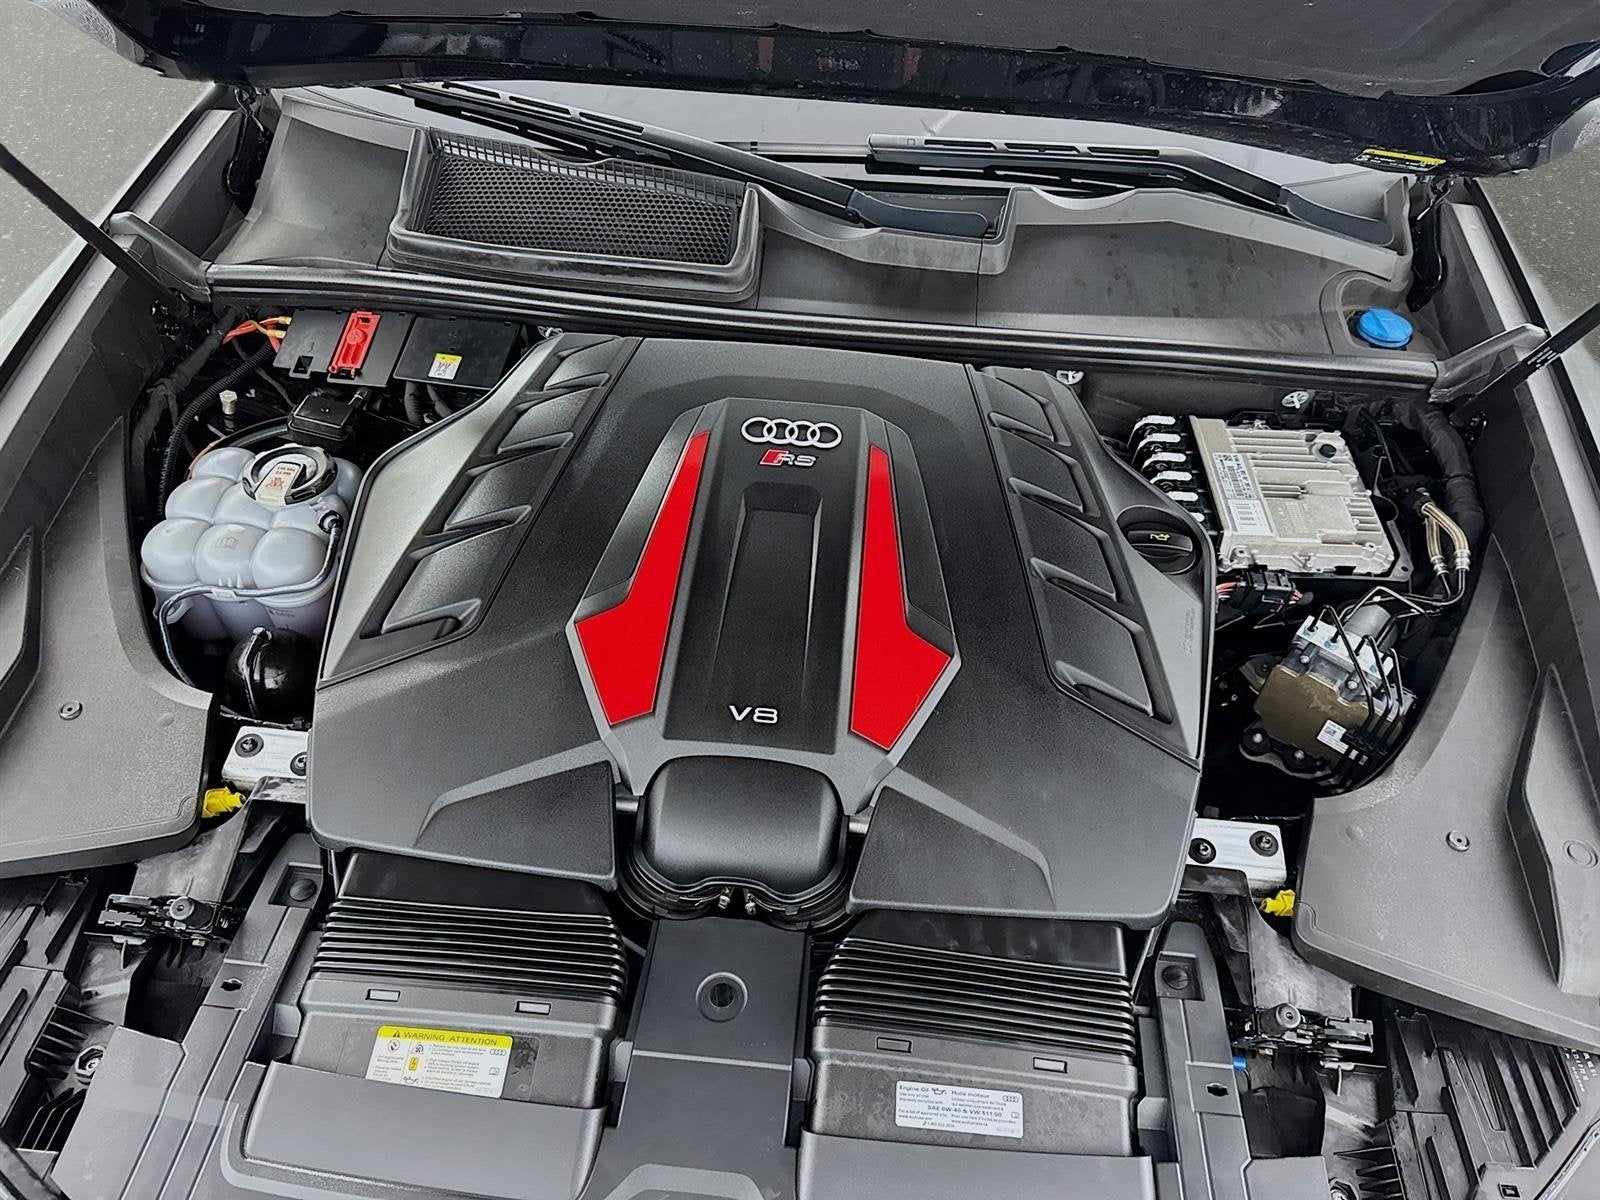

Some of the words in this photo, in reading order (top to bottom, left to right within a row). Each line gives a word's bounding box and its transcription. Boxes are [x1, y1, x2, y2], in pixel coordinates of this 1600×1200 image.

[766, 450, 817, 467] RS
[728, 705, 778, 724] V8
[404, 1031, 445, 1042] WARNING
[449, 1036, 498, 1046] ATTENTION
